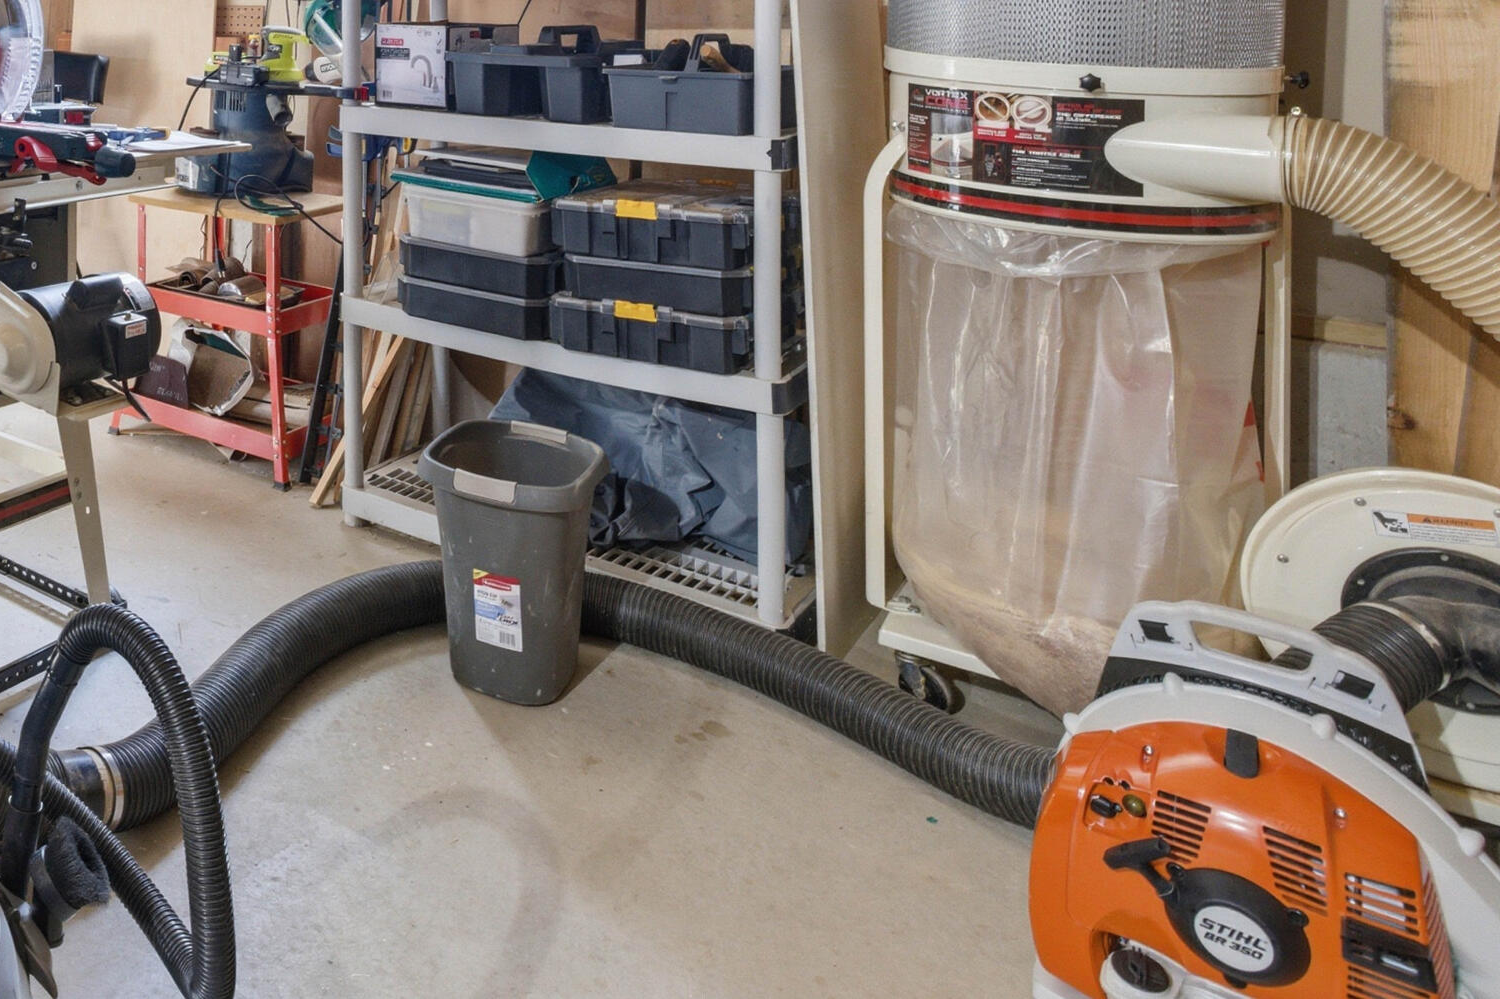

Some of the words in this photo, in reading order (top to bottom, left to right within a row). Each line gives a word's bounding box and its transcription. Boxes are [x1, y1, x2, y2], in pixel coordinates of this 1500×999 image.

[1199, 917, 1268, 952] STIHL
[1203, 931, 1228, 946] BR
[1228, 941, 1264, 960] 350
